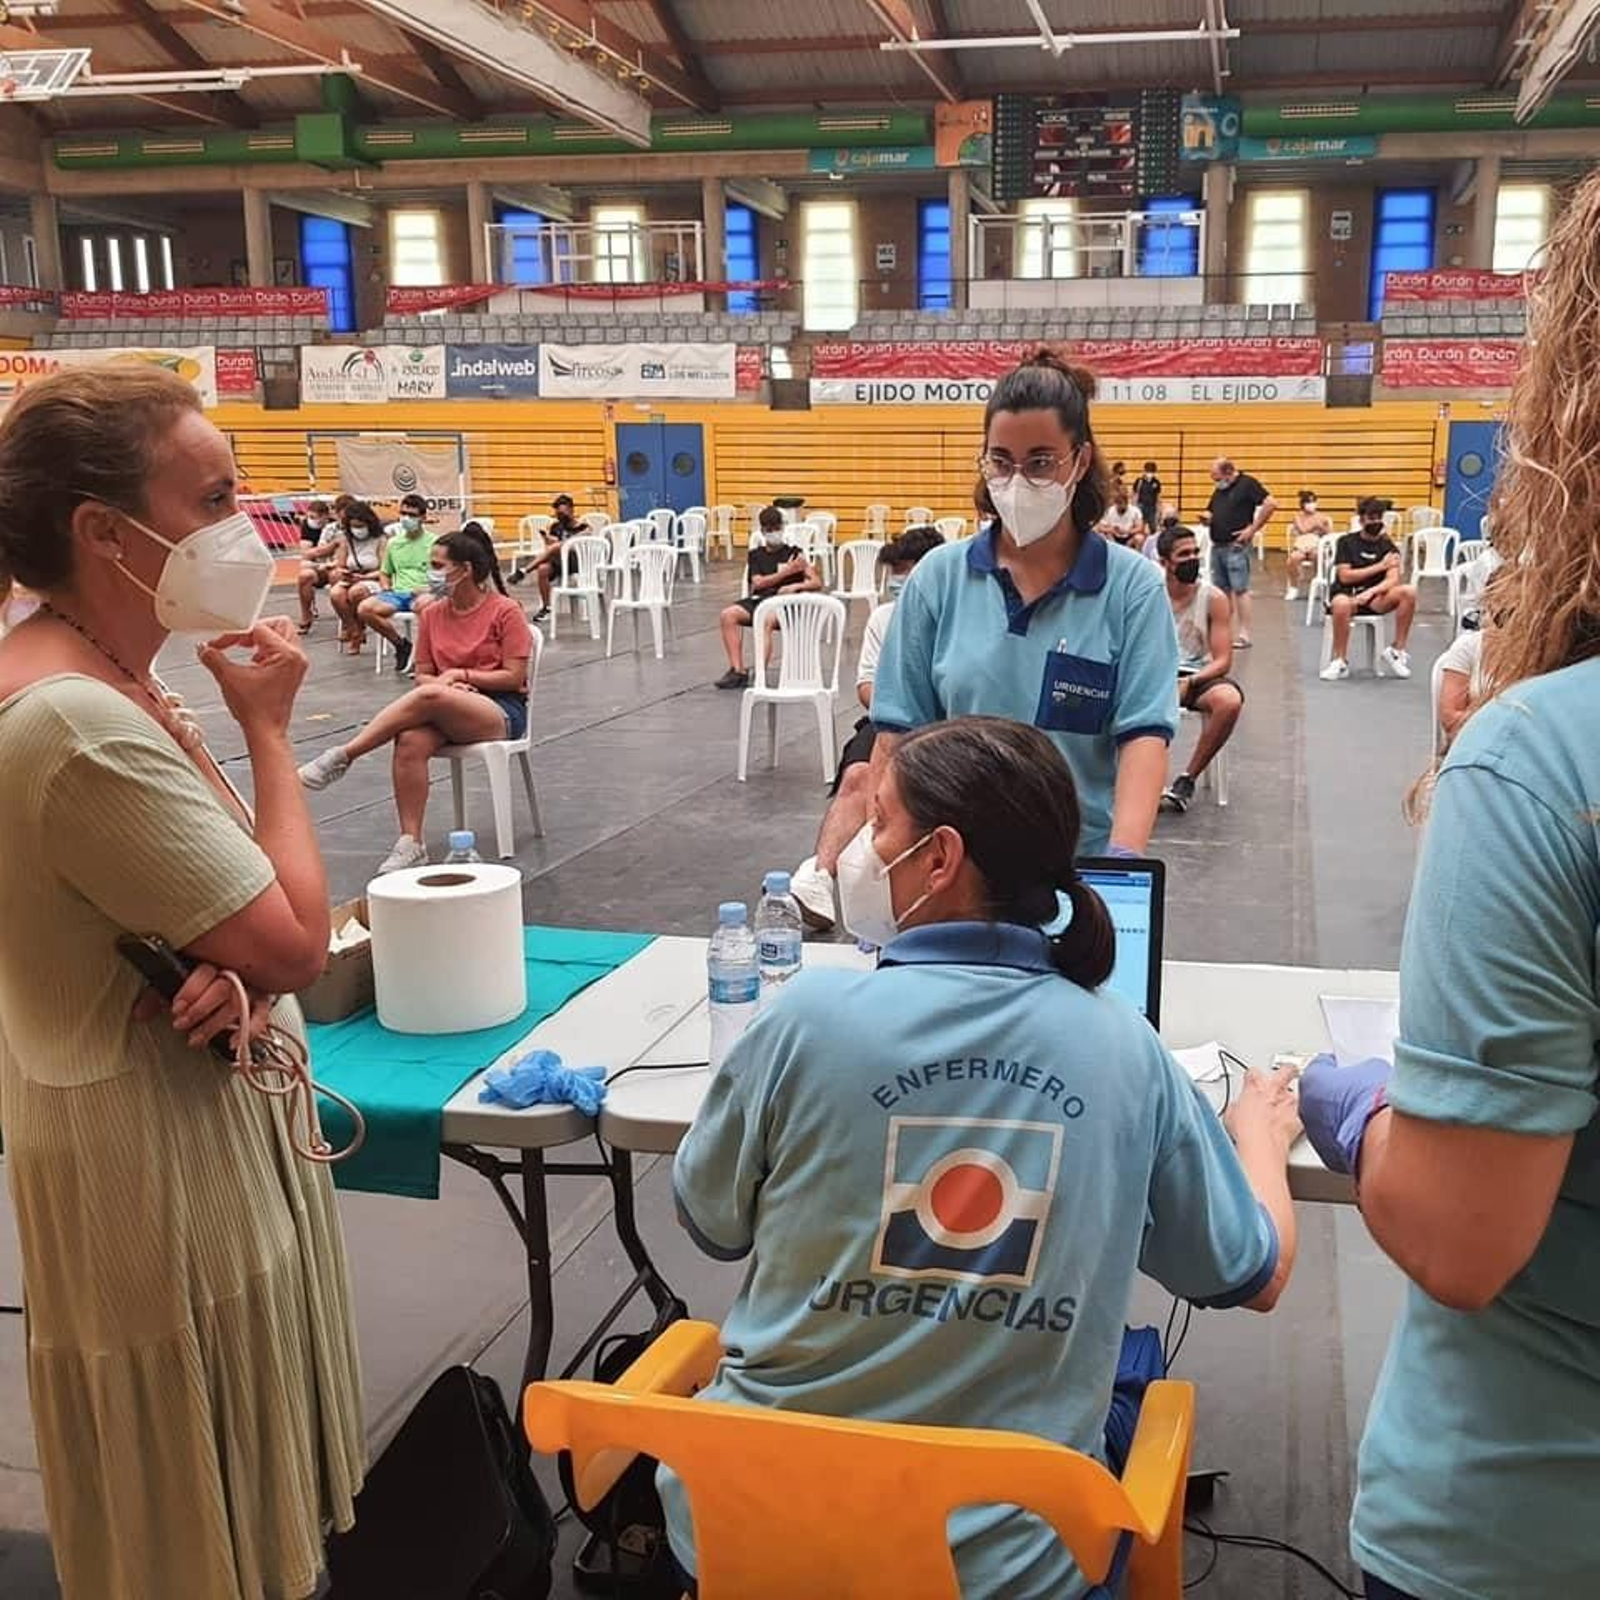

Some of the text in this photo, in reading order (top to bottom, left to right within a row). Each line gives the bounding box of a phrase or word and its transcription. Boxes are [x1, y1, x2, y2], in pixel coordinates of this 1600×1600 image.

[1284, 139, 1347, 155] cajamar
[851, 151, 909, 168] cajamar
[855, 383, 916, 404] EJIDO
[1112, 385, 1132, 401] 11
[1142, 385, 1167, 401] 08
[1191, 384, 1213, 401] EL
[1222, 384, 1279, 403] EJIDO
[871, 1057, 1086, 1120] ENFERMERO
[808, 1274, 1078, 1333] URGENCIAS
